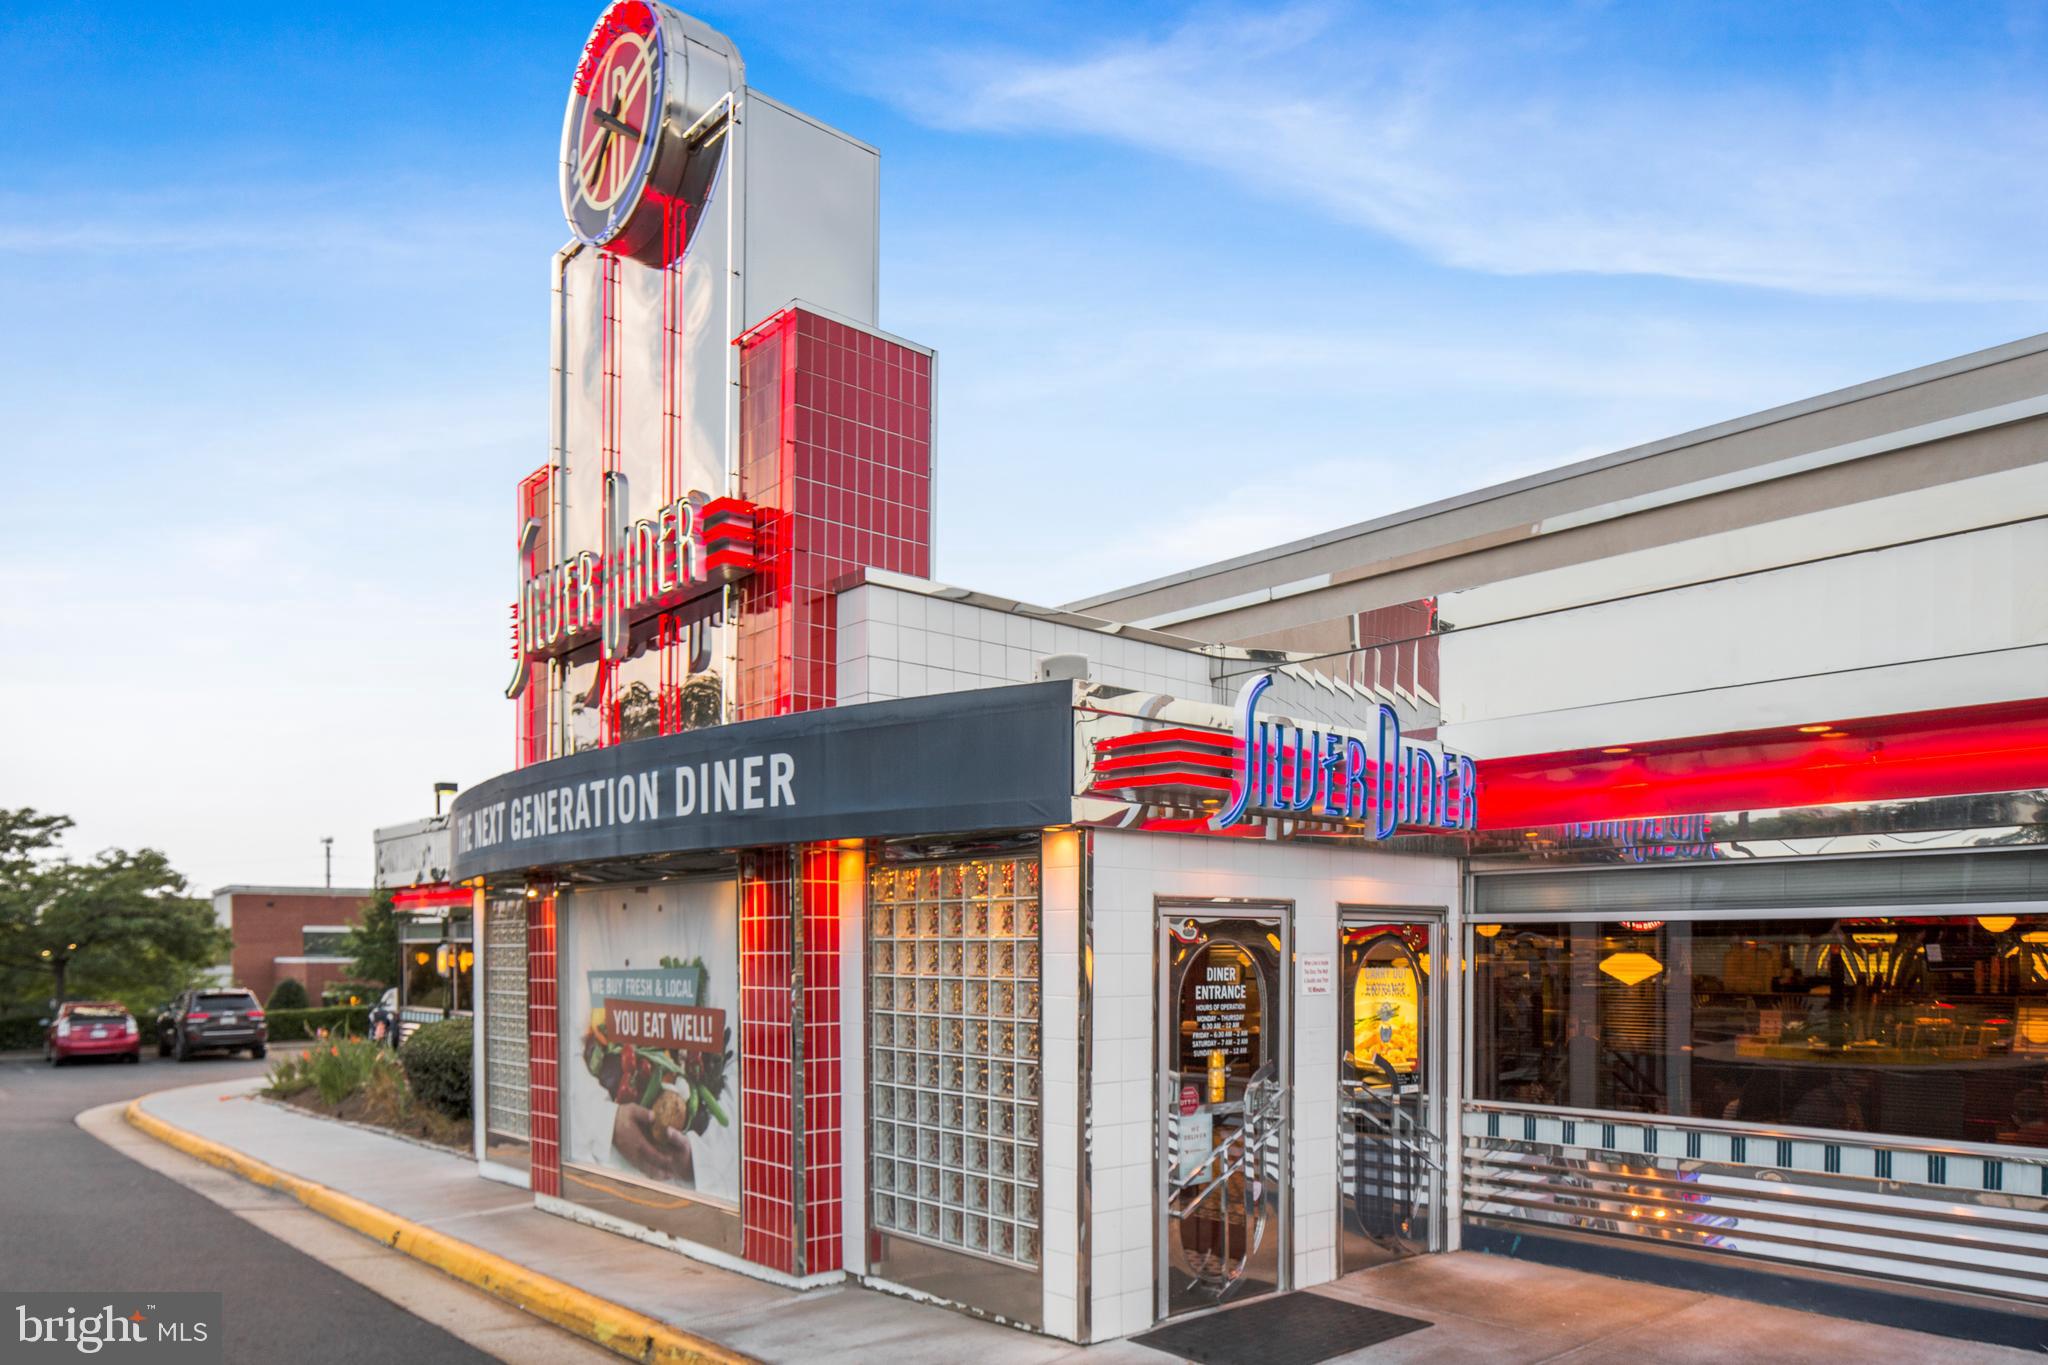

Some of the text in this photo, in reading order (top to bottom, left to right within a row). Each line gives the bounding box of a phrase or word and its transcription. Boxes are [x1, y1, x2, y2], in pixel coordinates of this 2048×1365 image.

[1207, 673, 1477, 840] SILVER DINER
[458, 752, 796, 853] THE NEXT GENERATION DINER
[1206, 966, 1236, 982] DINER
[591, 977, 694, 998] WE BUY FRESH & LOCAL
[1195, 984, 1247, 1000] ENTRANCE
[1196, 1003, 1246, 1012] HOURS OF OPERATION
[613, 1009, 713, 1043] YOU EAT WELL!
[1197, 1015, 1217, 1023] MONDAY
[1221, 1013, 1245, 1021] THURSDAY
[1192, 1031, 1209, 1039] FRIDAY
[1241, 1029, 1248, 1037] AM
[1192, 1040, 1217, 1048] SATURDAY
[1225, 1038, 1233, 1046] AM
